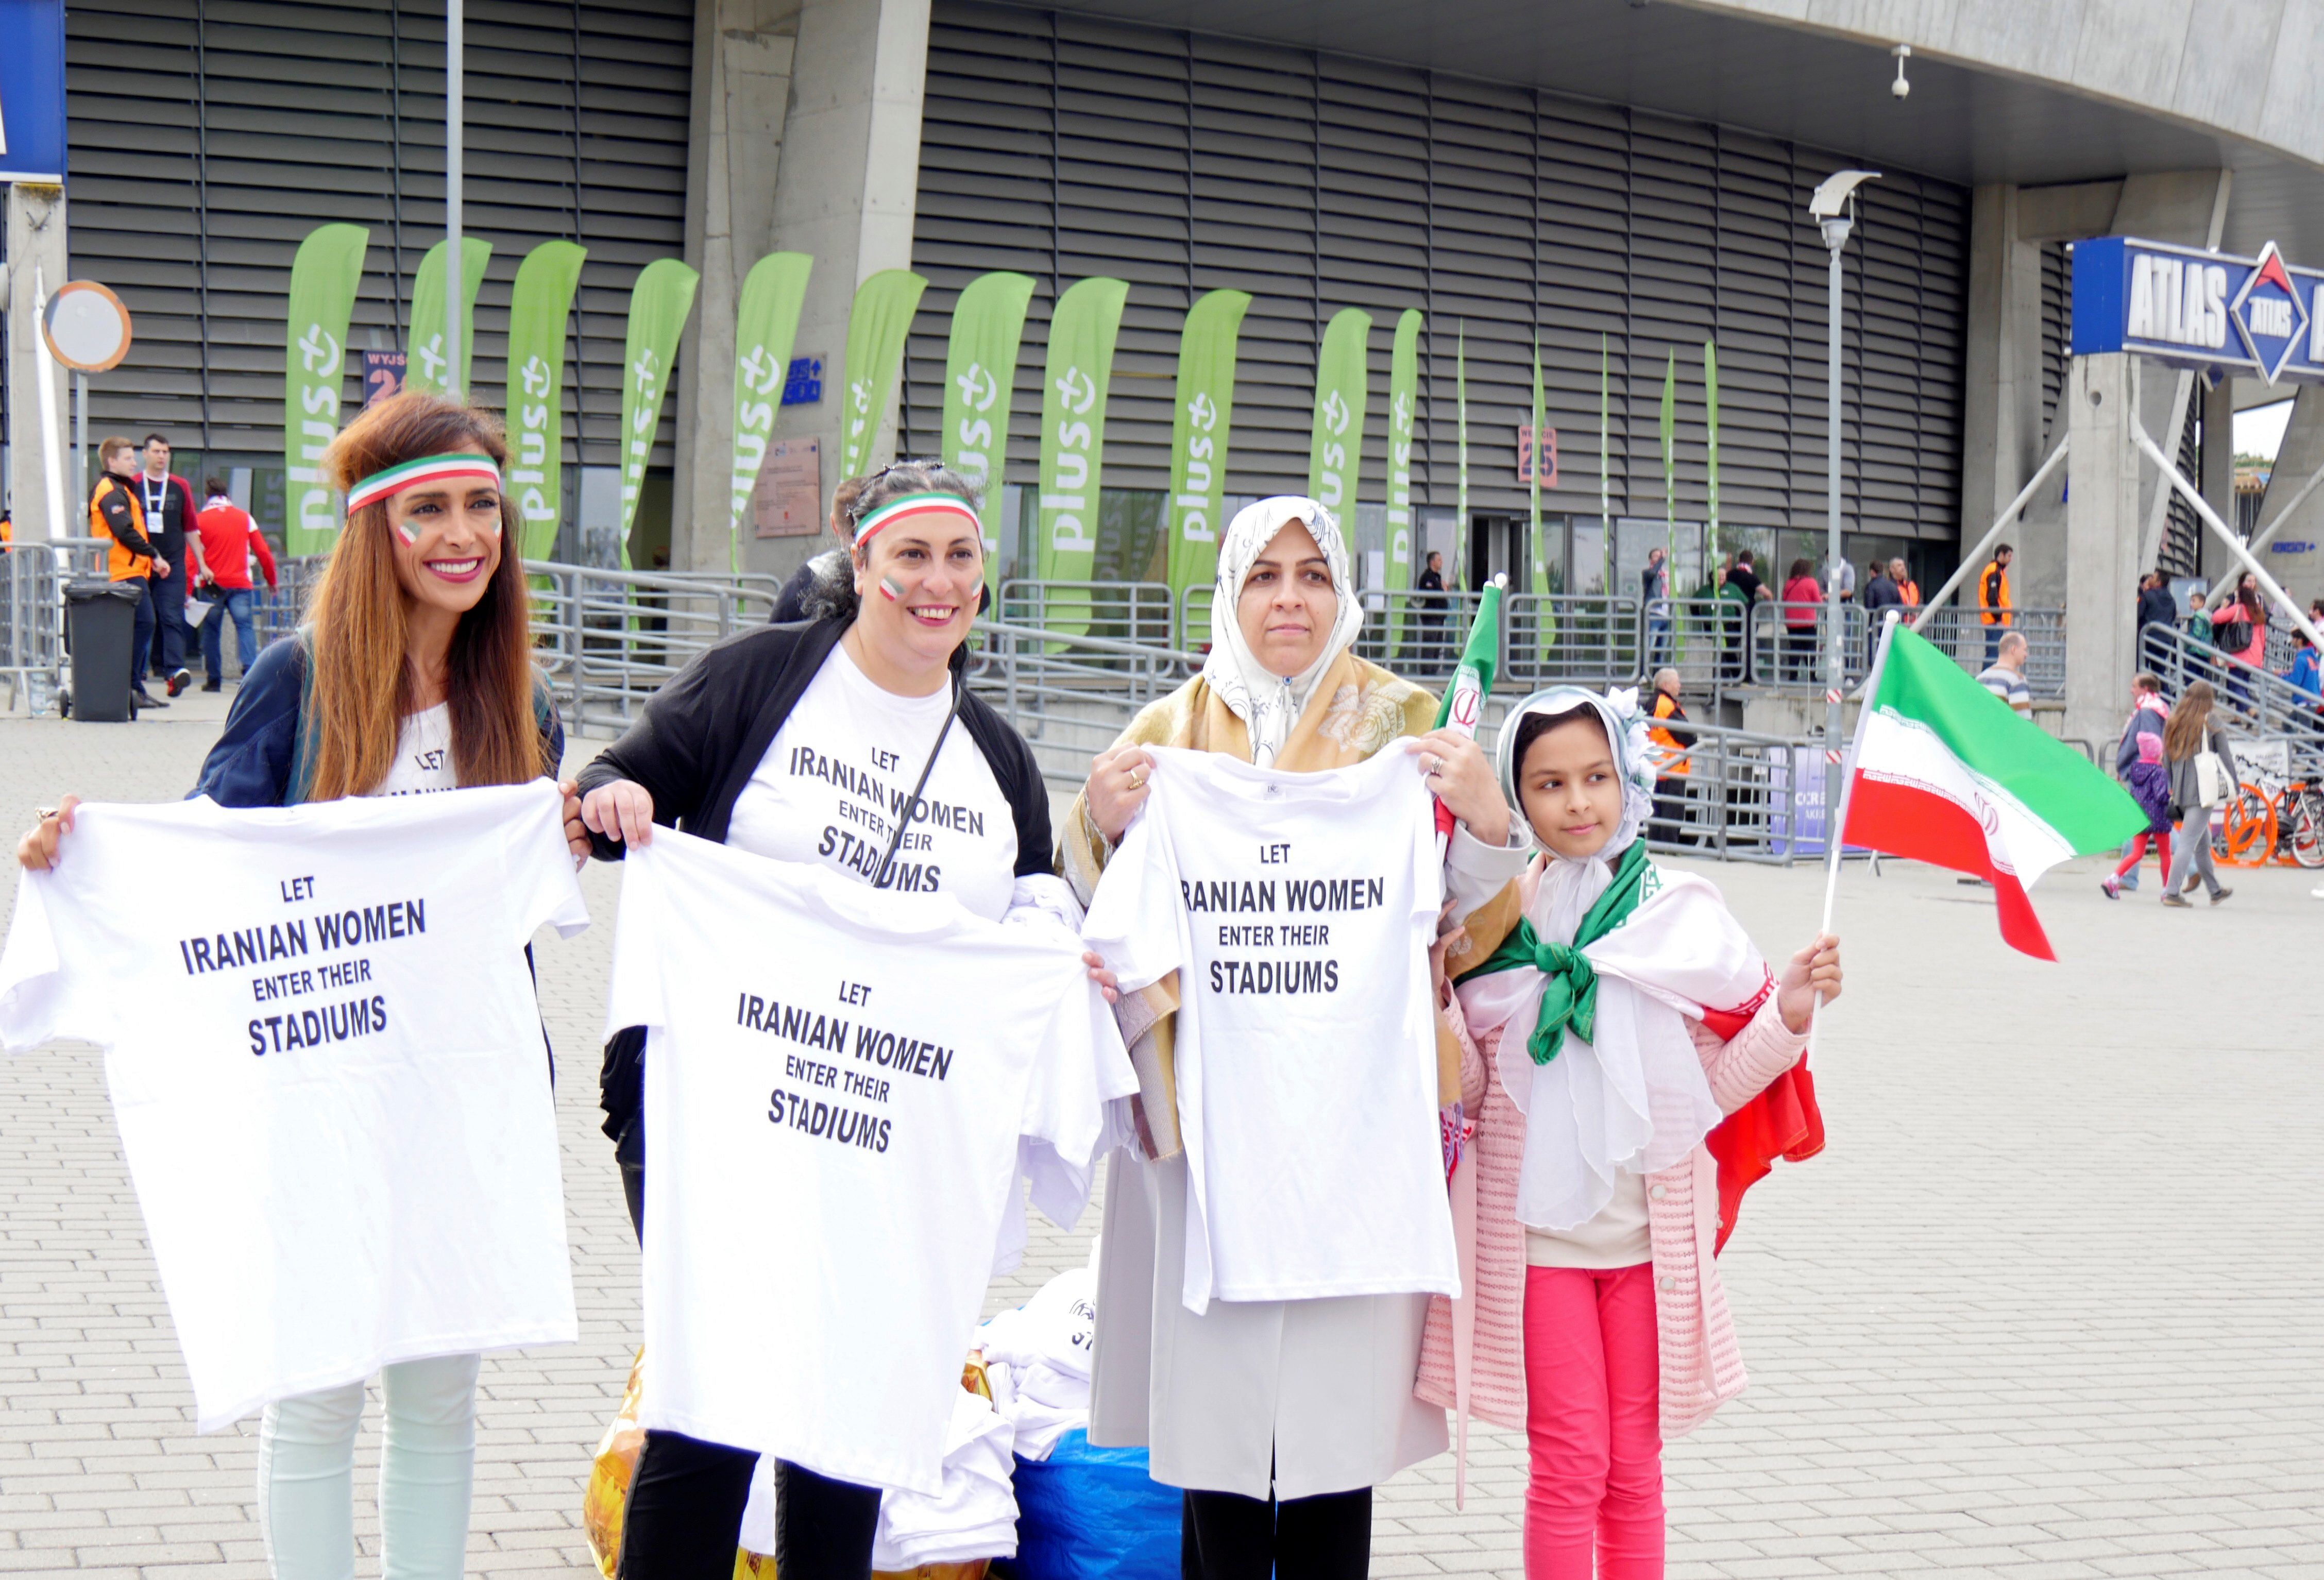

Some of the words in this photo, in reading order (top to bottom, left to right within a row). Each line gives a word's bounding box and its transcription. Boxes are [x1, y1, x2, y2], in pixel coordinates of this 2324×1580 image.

[2128, 253, 2227, 349] ATLAS
[2248, 296, 2291, 338] ATLAS
[367, 351, 406, 366] WYJŚ
[1521, 429, 1553, 440] WECIE
[289, 385, 337, 530] plus
[512, 404, 555, 520] plus
[1522, 442, 1553, 477] 25
[1041, 420, 1095, 552] plus
[1176, 435, 1215, 543] plus
[414, 749, 445, 771] LET
[872, 747, 900, 773] LET
[790, 746, 884, 808] IRANIAN
[890, 788, 984, 837] WOMEN
[839, 800, 884, 837] ENTER
[818, 826, 941, 892] STADIUMS
[1260, 844, 1291, 863] LET
[281, 876, 314, 903] LET
[1180, 879, 1275, 912] RANIAN
[1285, 876, 1384, 912] WOMEN
[180, 920, 309, 975] IRANIAN
[314, 898, 426, 951] WOMEN
[1219, 926, 1274, 946] ENTER
[1280, 925, 1329, 946] THEIR
[252, 970, 314, 1001] ENTER
[317, 959, 371, 989] THEIR
[839, 980, 872, 1007] LET
[1210, 959, 1338, 994] STADIUMS
[248, 995, 387, 1056] STADIUMS
[737, 993, 849, 1054] IRANIAN
[855, 1025, 954, 1081] WOMEN
[786, 1055, 838, 1089] ENTER
[844, 1071, 890, 1103] THEIR
[768, 1089, 891, 1153] STADIUMS
